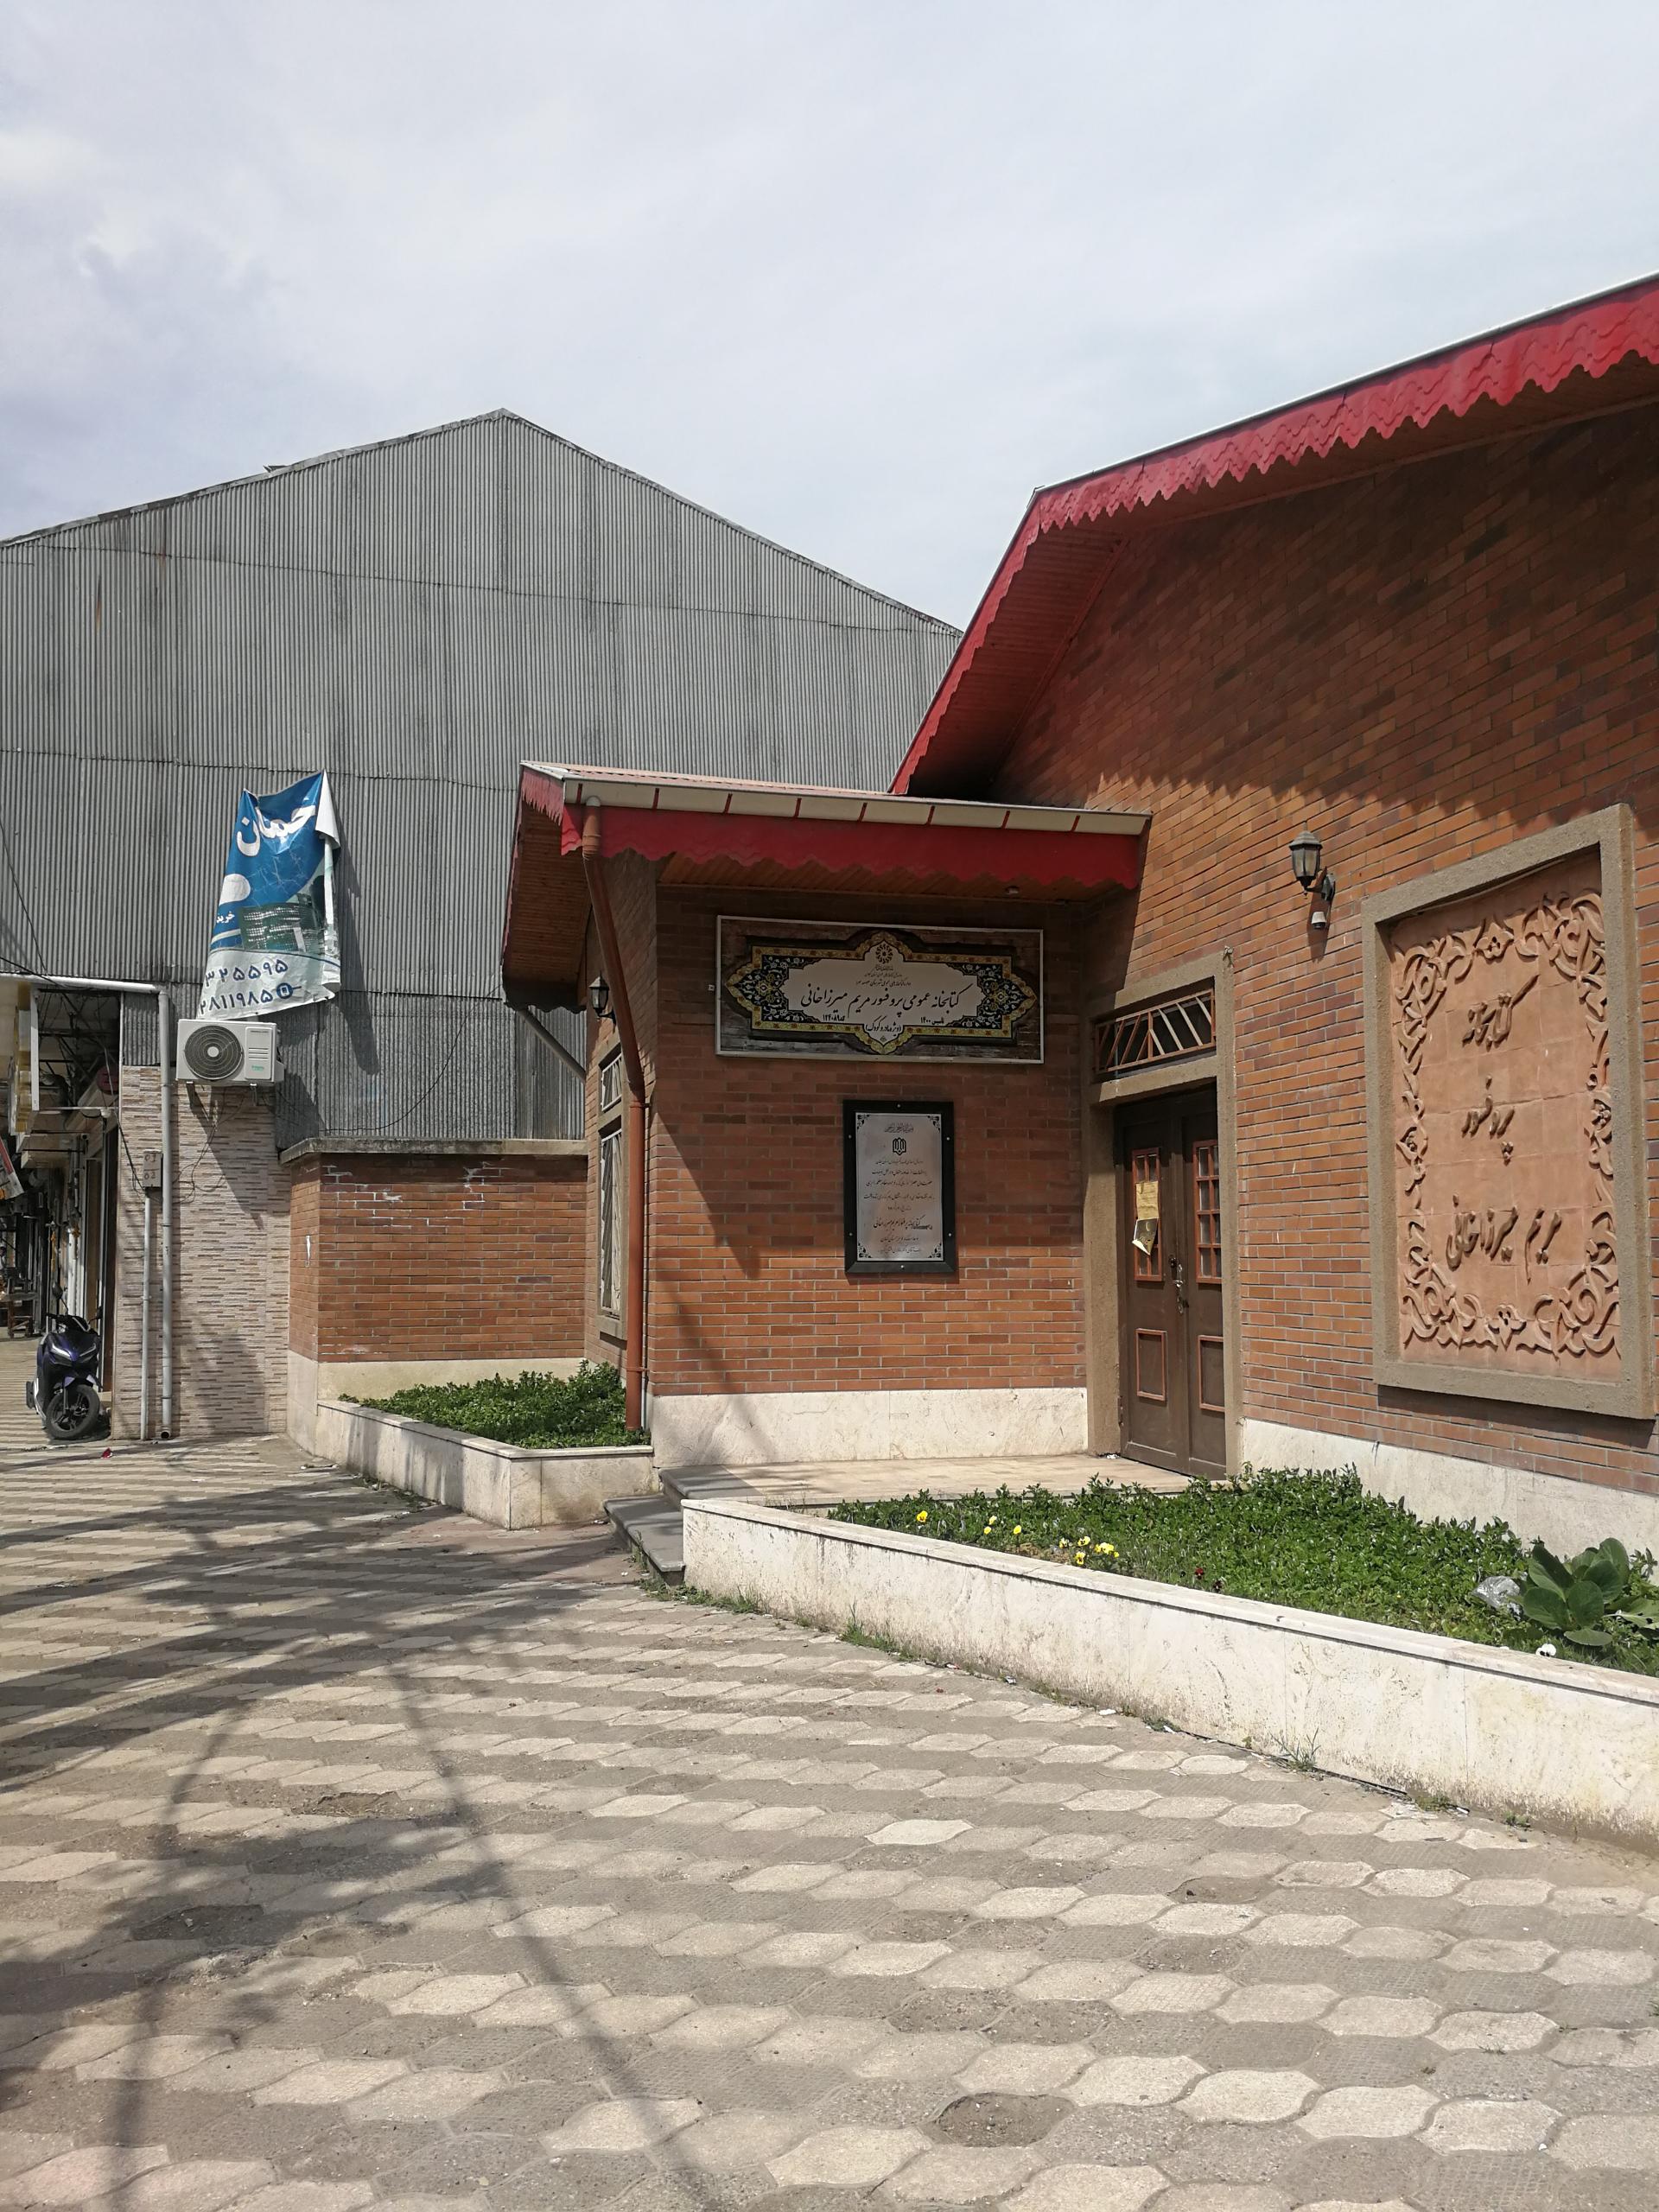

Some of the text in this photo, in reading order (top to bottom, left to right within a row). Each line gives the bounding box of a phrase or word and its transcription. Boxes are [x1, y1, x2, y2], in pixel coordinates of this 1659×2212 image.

[800, 983, 848, 1013] میرزاخانی
[848, 995, 870, 1019] مریم
[903, 993, 931, 1011] عمومی
[932, 983, 974, 1014] کتابخانه
[1463, 974, 1540, 1052] کتابخانه
[1446, 1193, 1562, 1286] مریم میرزاخانی
